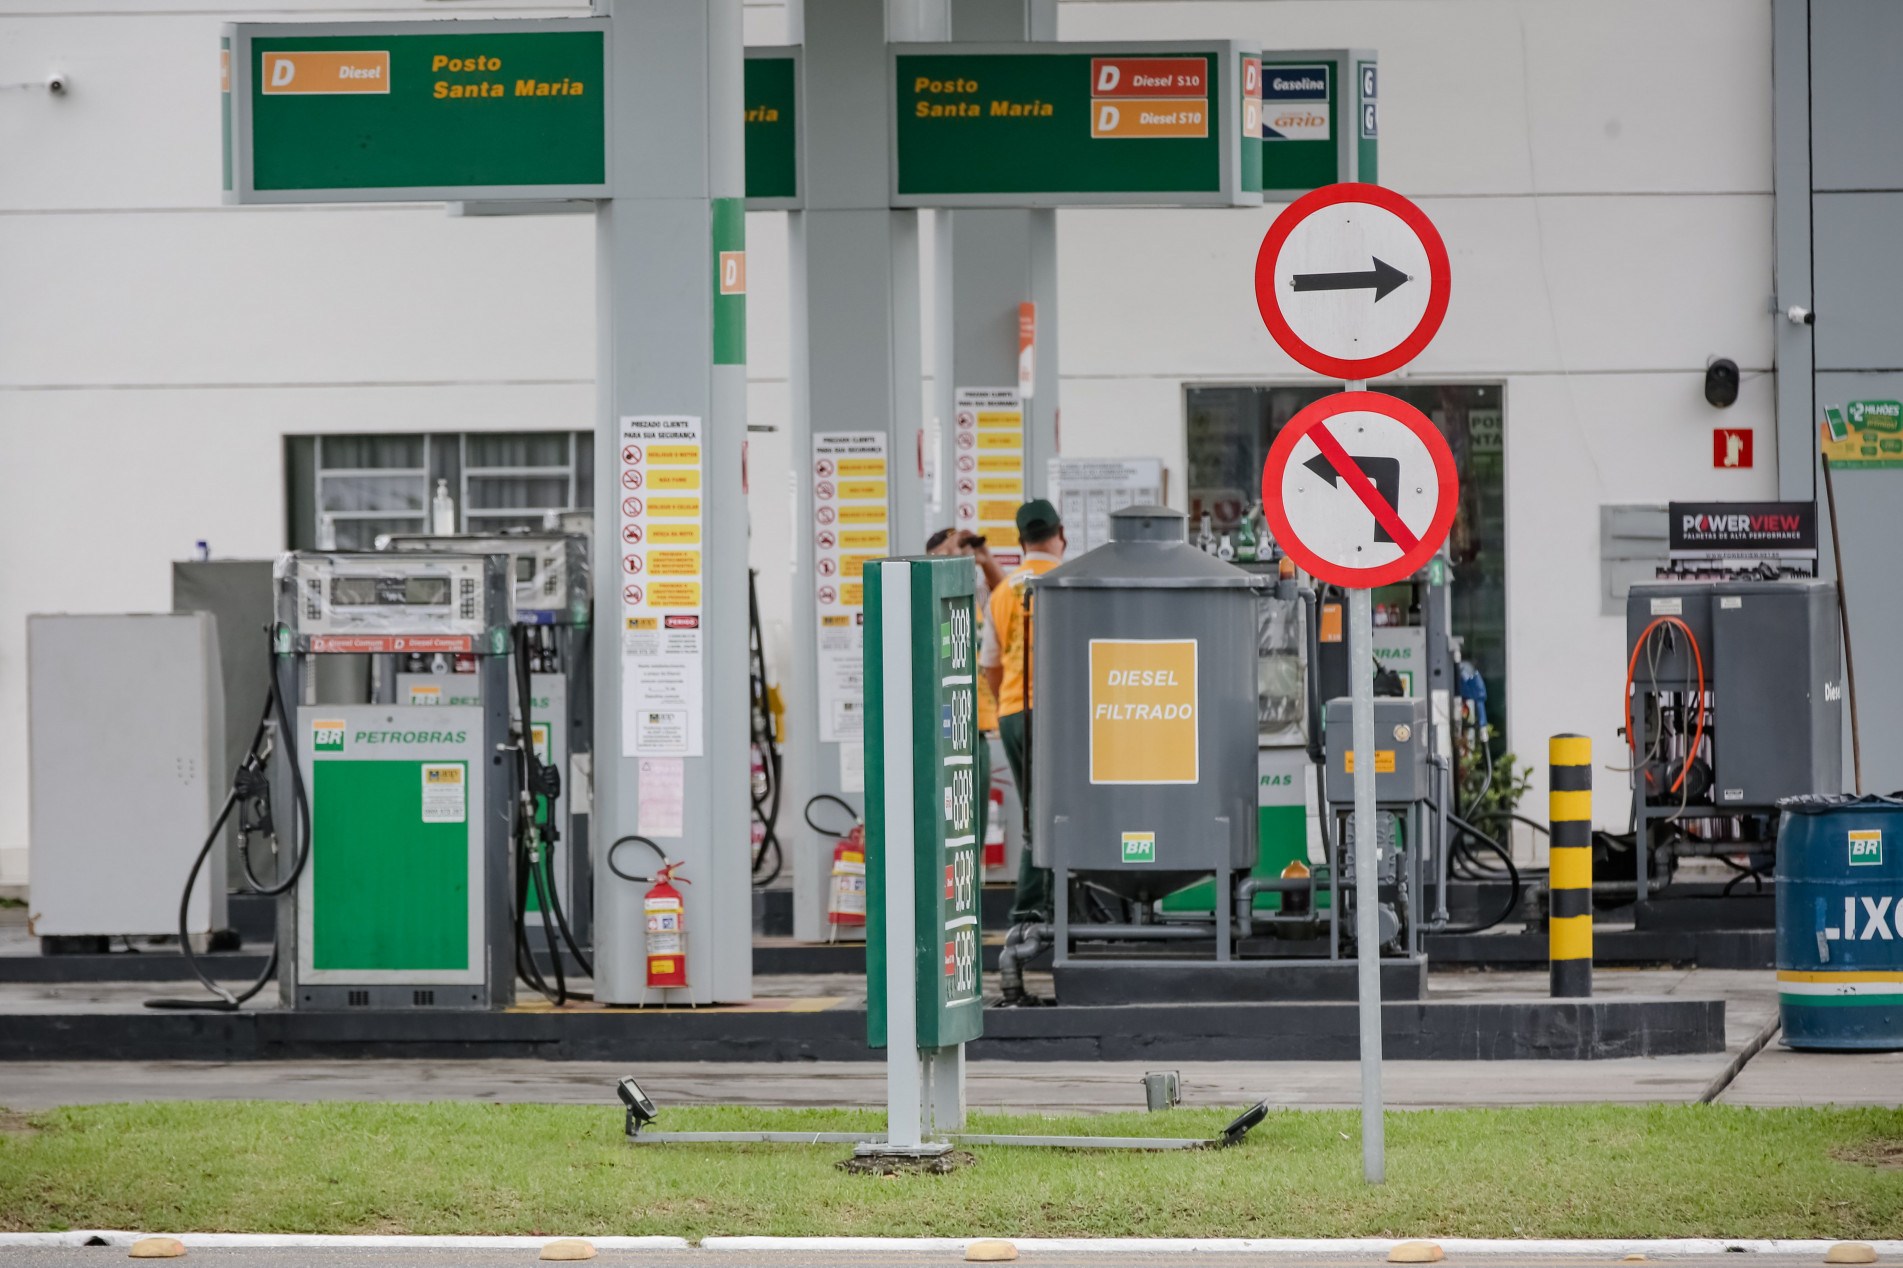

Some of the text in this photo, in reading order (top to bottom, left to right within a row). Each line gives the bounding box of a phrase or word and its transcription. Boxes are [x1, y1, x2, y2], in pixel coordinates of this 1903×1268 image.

[271, 59, 381, 87] D Diesel
[432, 54, 502, 73] Posto
[915, 76, 978, 94] Posto
[1097, 65, 1200, 91] D Diesel S10
[1246, 65, 1256, 91] D
[1273, 77, 1324, 91] Gasolina
[1364, 70, 1374, 95] G
[433, 78, 584, 99] Santa Maria
[744, 105, 778, 122] ria
[916, 99, 1053, 118] Santa Maria
[1246, 106, 1256, 129] D
[1364, 106, 1374, 130] G
[1097, 106, 1202, 131] D Diesel S10
[725, 259, 737, 287] D
[1683, 514, 1800, 532] POWERVIEW
[1108, 670, 1178, 686] DIESEL
[1095, 704, 1193, 720] FILTRADO
[316, 731, 467, 745] BR PETROBRAS
[1126, 842, 1151, 854] BR
[1852, 841, 1878, 856] BR
